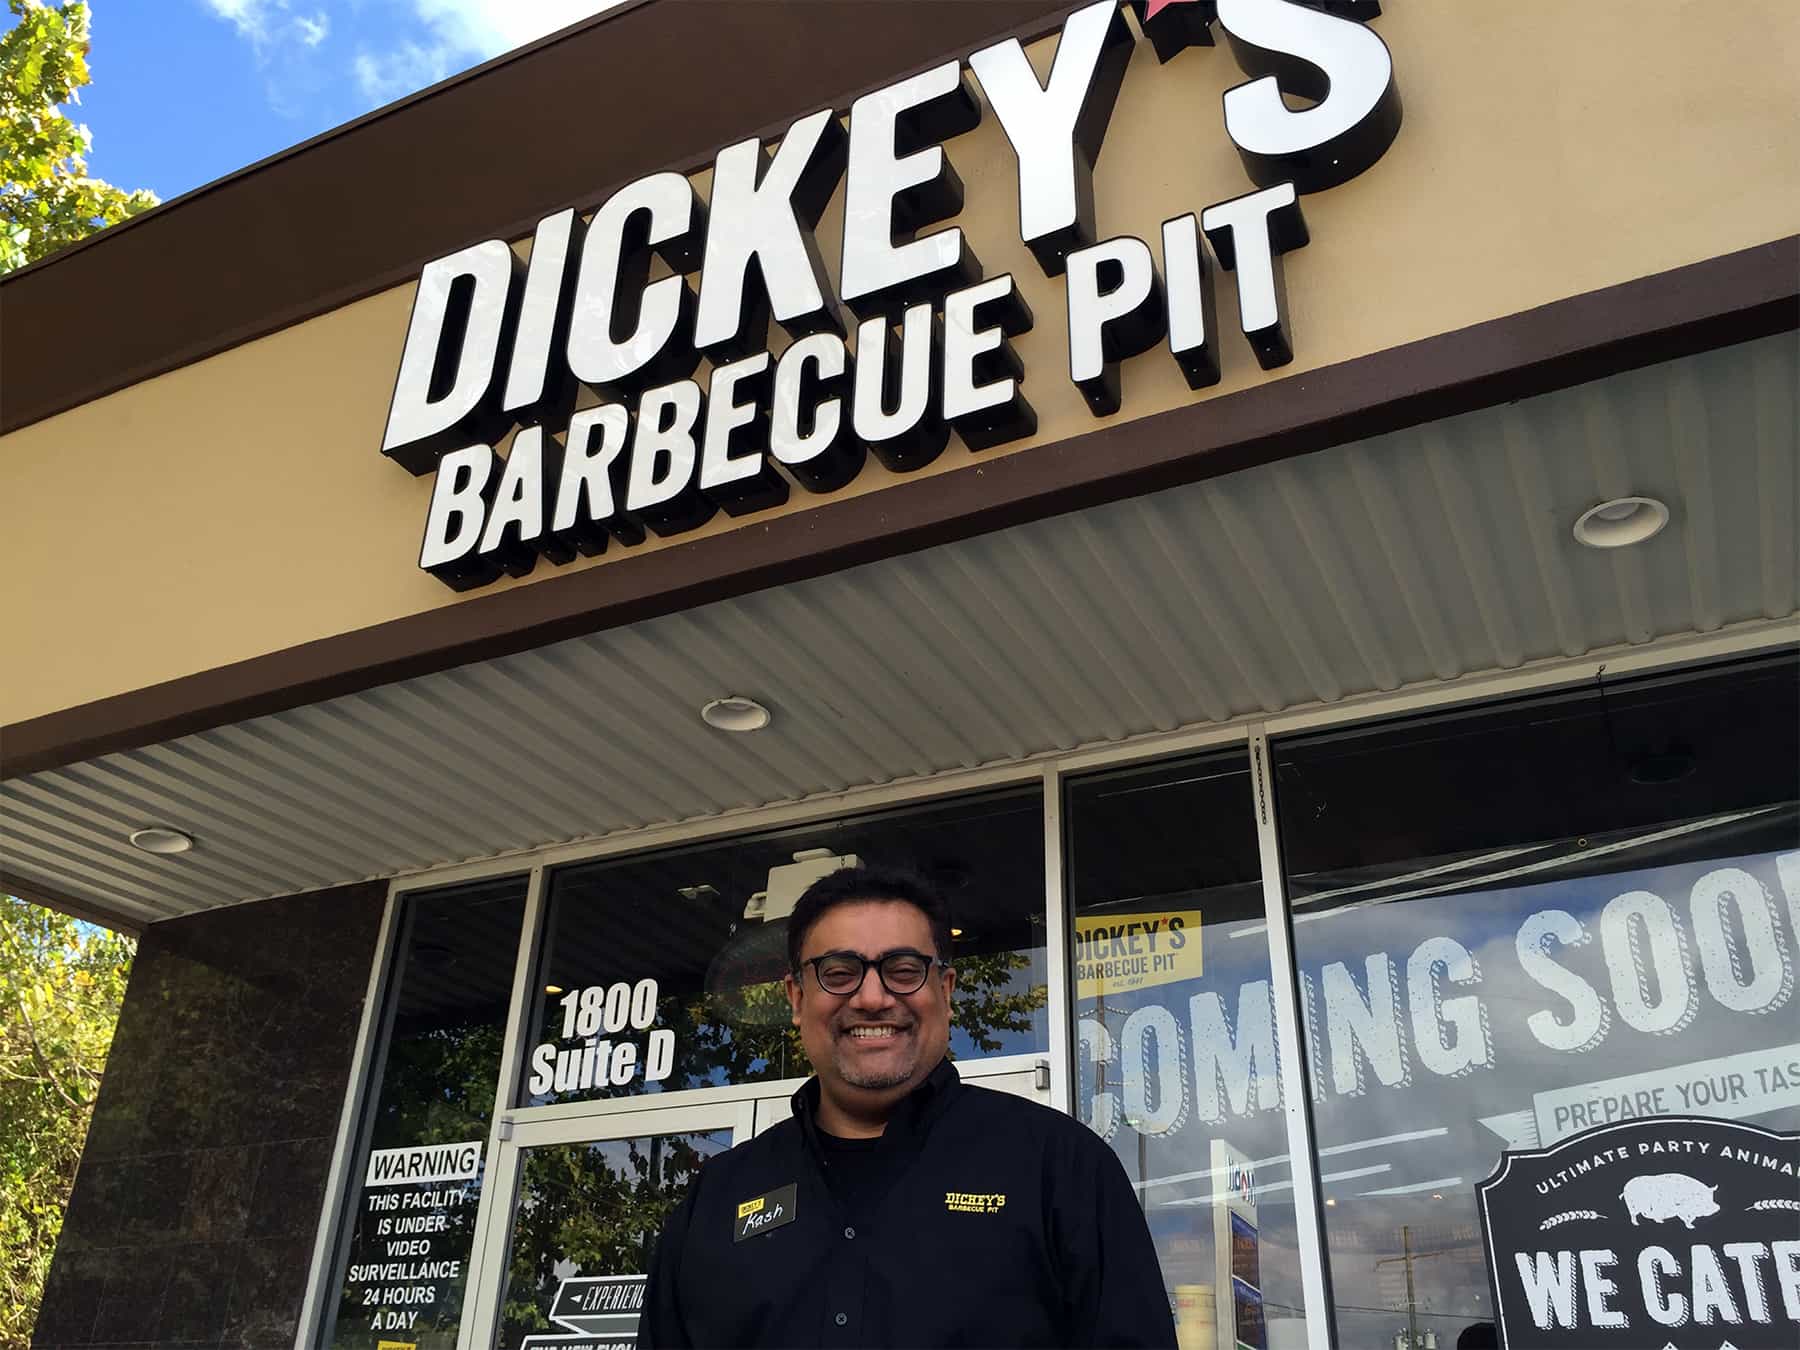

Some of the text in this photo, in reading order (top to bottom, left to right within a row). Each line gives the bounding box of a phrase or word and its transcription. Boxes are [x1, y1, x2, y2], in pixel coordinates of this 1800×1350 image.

[382, 0, 1393, 453] DICKEYS
[418, 181, 1296, 569] BARBECUE PIT
[1078, 953, 1176, 980] BARBECUE PIT
[560, 978, 658, 1039] 1800
[528, 1029, 675, 1095] Suite D
[1554, 1088, 1670, 1132] PREPARE
[1676, 1073, 1748, 1109] YOUR
[374, 1147, 476, 1180] WARNING
[1536, 1146, 1631, 1194] ULTIMATE
[1638, 1140, 1711, 1156] PARTY
[368, 1188, 468, 1212] THIS FACILITY
[377, 1215, 446, 1235] IS UNDER
[742, 1203, 784, 1235] Kash
[386, 1239, 431, 1257] VIDEO
[348, 1261, 461, 1282] SURVEILLANCE
[362, 1286, 436, 1306] 24 HOURS
[1514, 1249, 1628, 1329] WE
[370, 1311, 419, 1330] A DAY
